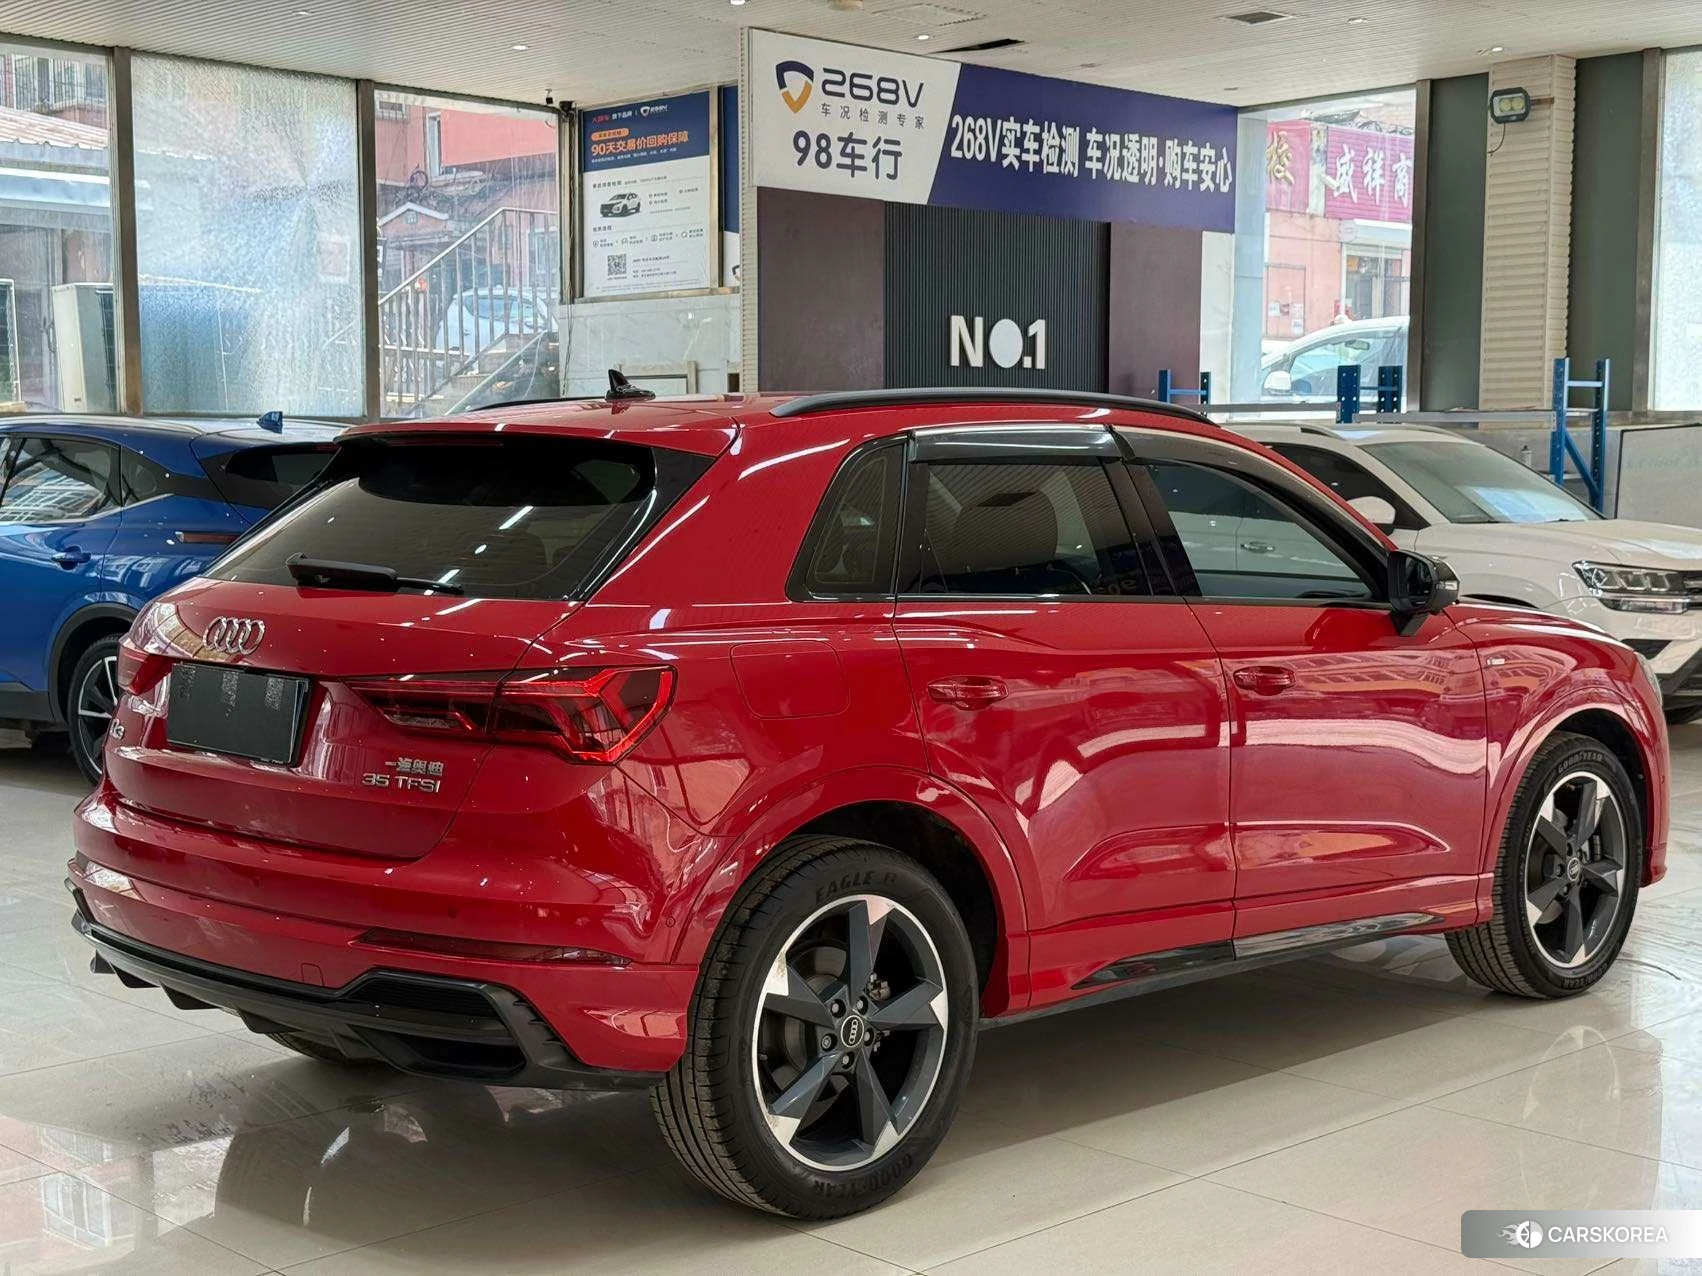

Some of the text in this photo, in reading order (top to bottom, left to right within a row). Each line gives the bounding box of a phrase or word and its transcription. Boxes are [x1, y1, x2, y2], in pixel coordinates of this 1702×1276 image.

[822, 67, 925, 108] 268V
[821, 102, 925, 130] 车况检测专家
[793, 130, 903, 180] 98车行
[950, 114, 1080, 178] 268V实车检测
[1085, 127, 1233, 193] 车况透明·购车安心
[949, 314, 1046, 370] NO.1
[361, 772, 441, 793] 35 TFSI
